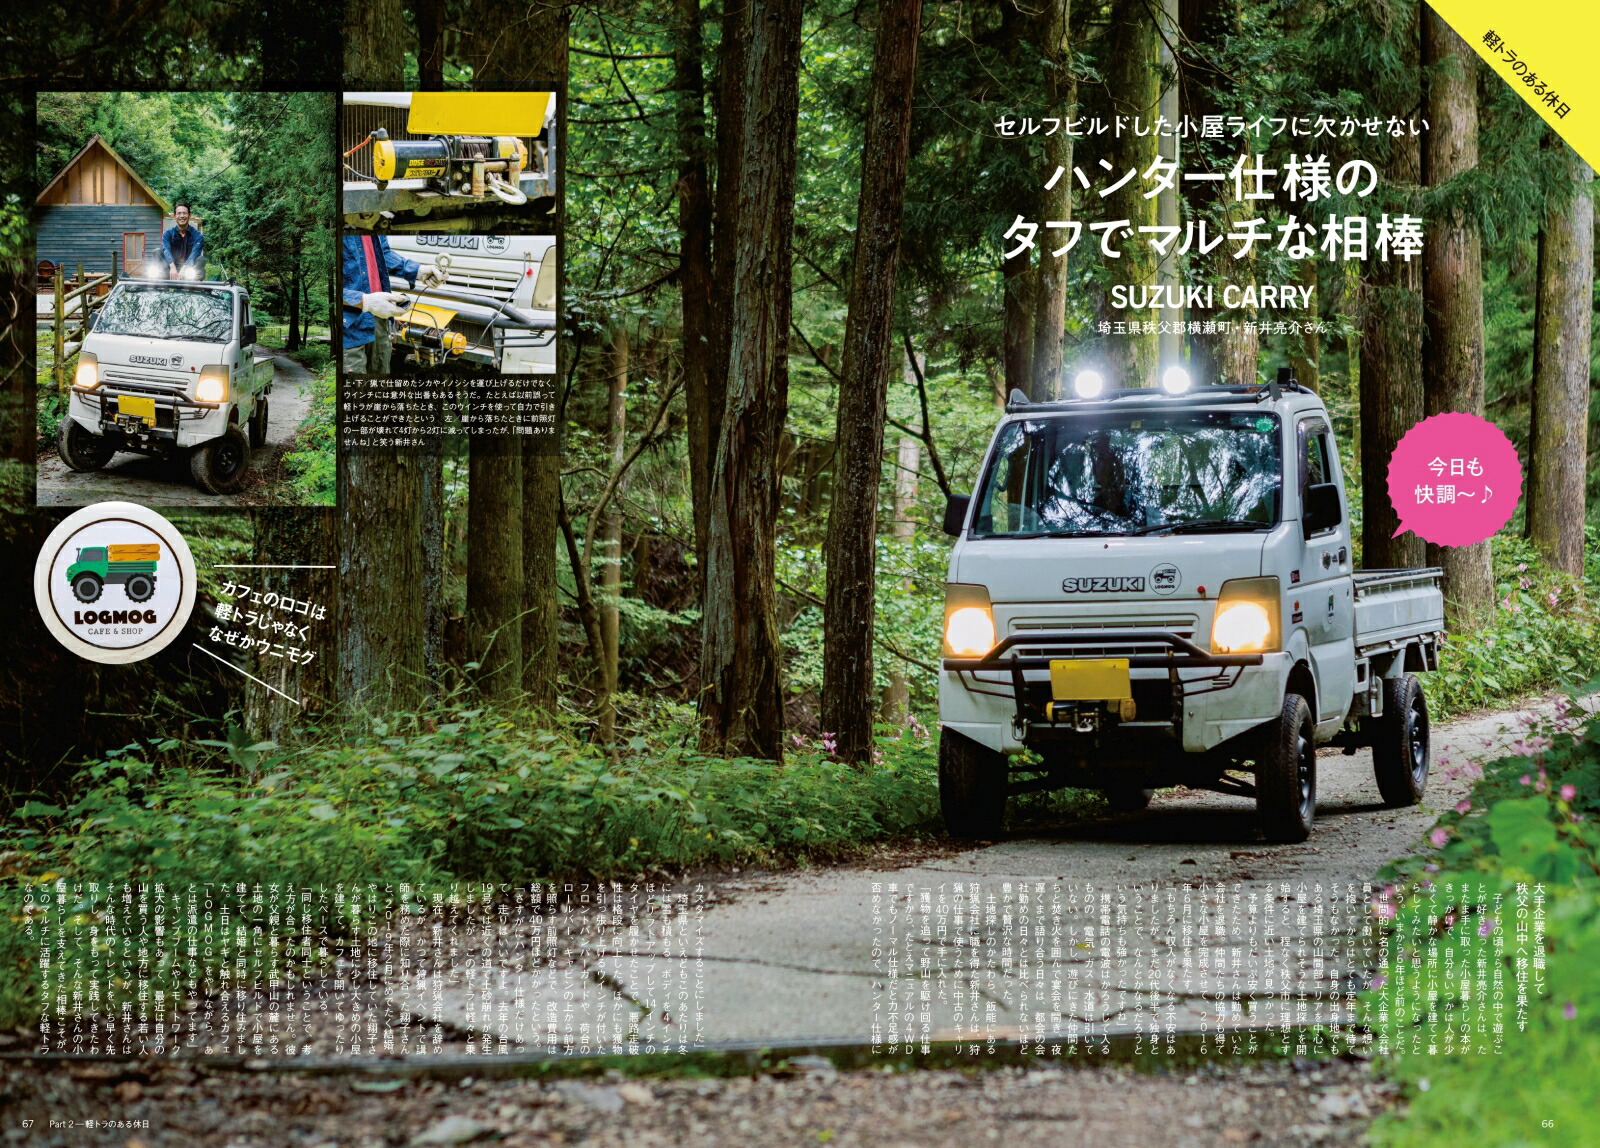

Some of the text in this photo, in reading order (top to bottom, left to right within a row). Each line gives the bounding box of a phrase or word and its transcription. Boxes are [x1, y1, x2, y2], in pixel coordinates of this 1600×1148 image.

[417, 235, 480, 250] SUZUKI
[129, 354, 168, 367] SUZUKI
[1062, 577, 1145, 593] SUZUKI
[74, 610, 157, 625] LOGMOG
